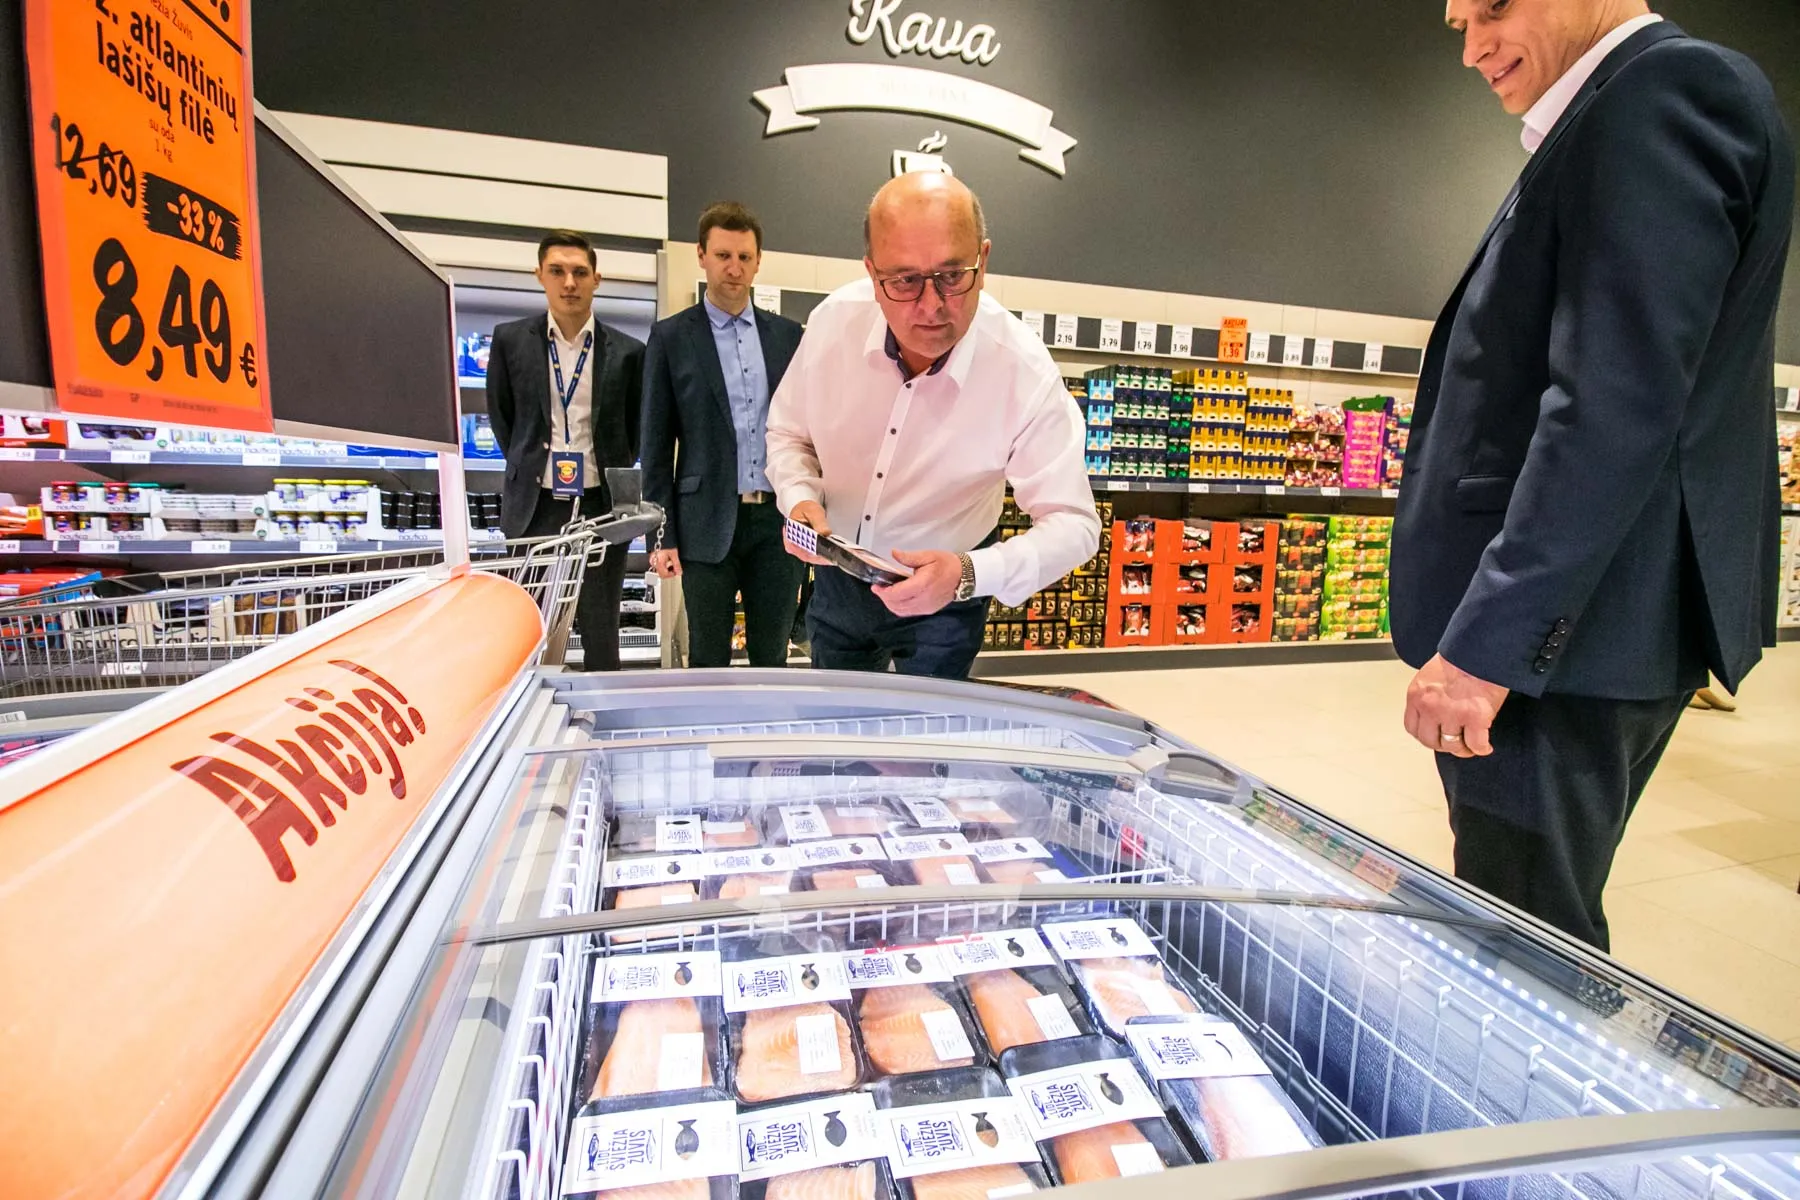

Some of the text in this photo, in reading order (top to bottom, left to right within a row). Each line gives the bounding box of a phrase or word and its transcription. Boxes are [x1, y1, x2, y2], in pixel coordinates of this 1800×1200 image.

[848, 0, 1001, 63] Kava
[96, 20, 215, 145] lašišų filė
[130, 11, 239, 132] atlantinių
[161, 126, 175, 144] oda
[51, 112, 137, 208] 12,69
[93, 237, 259, 388] 8,49 €
[170, 659, 426, 883] Akcija!
[1046, 1084, 1073, 1119] ŠVIEŽIA
[1060, 1084, 1086, 1112] ŽUVIS
[606, 1128, 629, 1171] ŠVIEŽIA
[627, 1130, 646, 1165] ŽUVIS
[763, 1122, 784, 1161] ŠVIEŽIA
[781, 1123, 800, 1154] ŽUVIS
[917, 1119, 941, 1158] ŠVIEŽIA
[932, 1121, 955, 1152] ŽUVIS
